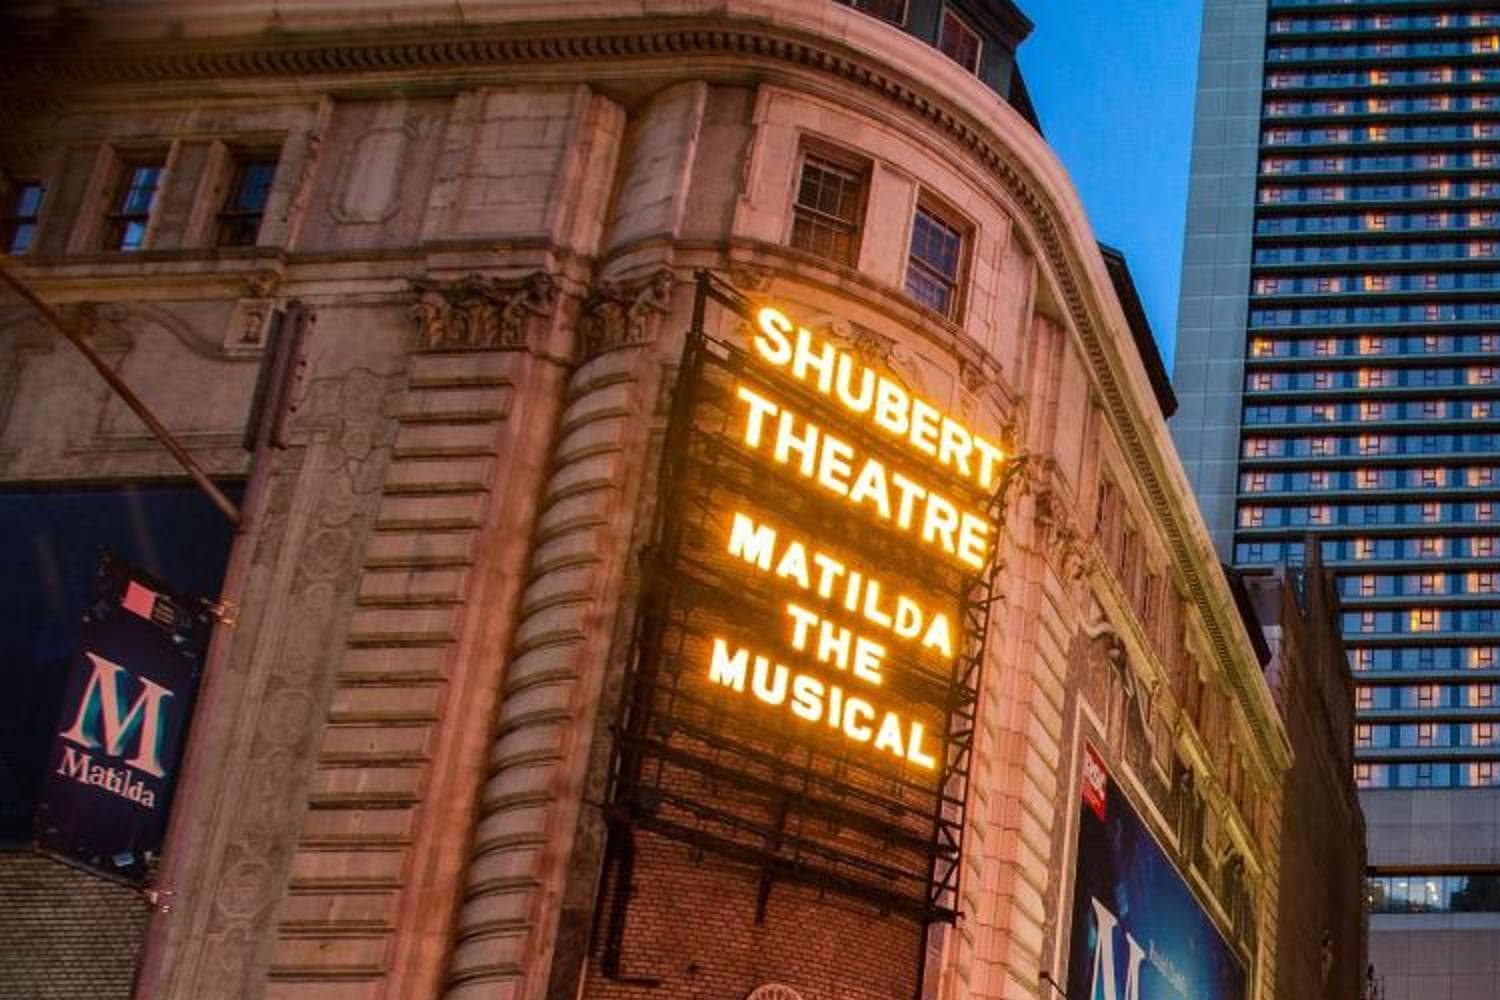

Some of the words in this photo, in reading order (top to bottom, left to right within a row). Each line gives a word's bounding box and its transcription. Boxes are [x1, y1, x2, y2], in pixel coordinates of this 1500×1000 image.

[753, 306, 1004, 489] SHUBERT
[737, 388, 991, 570] THEATRE
[727, 513, 952, 657] MATILDA
[787, 604, 885, 684] THE
[60, 651, 174, 778] M
[709, 638, 938, 771] MUSICAL
[57, 746, 156, 808] Matilda
